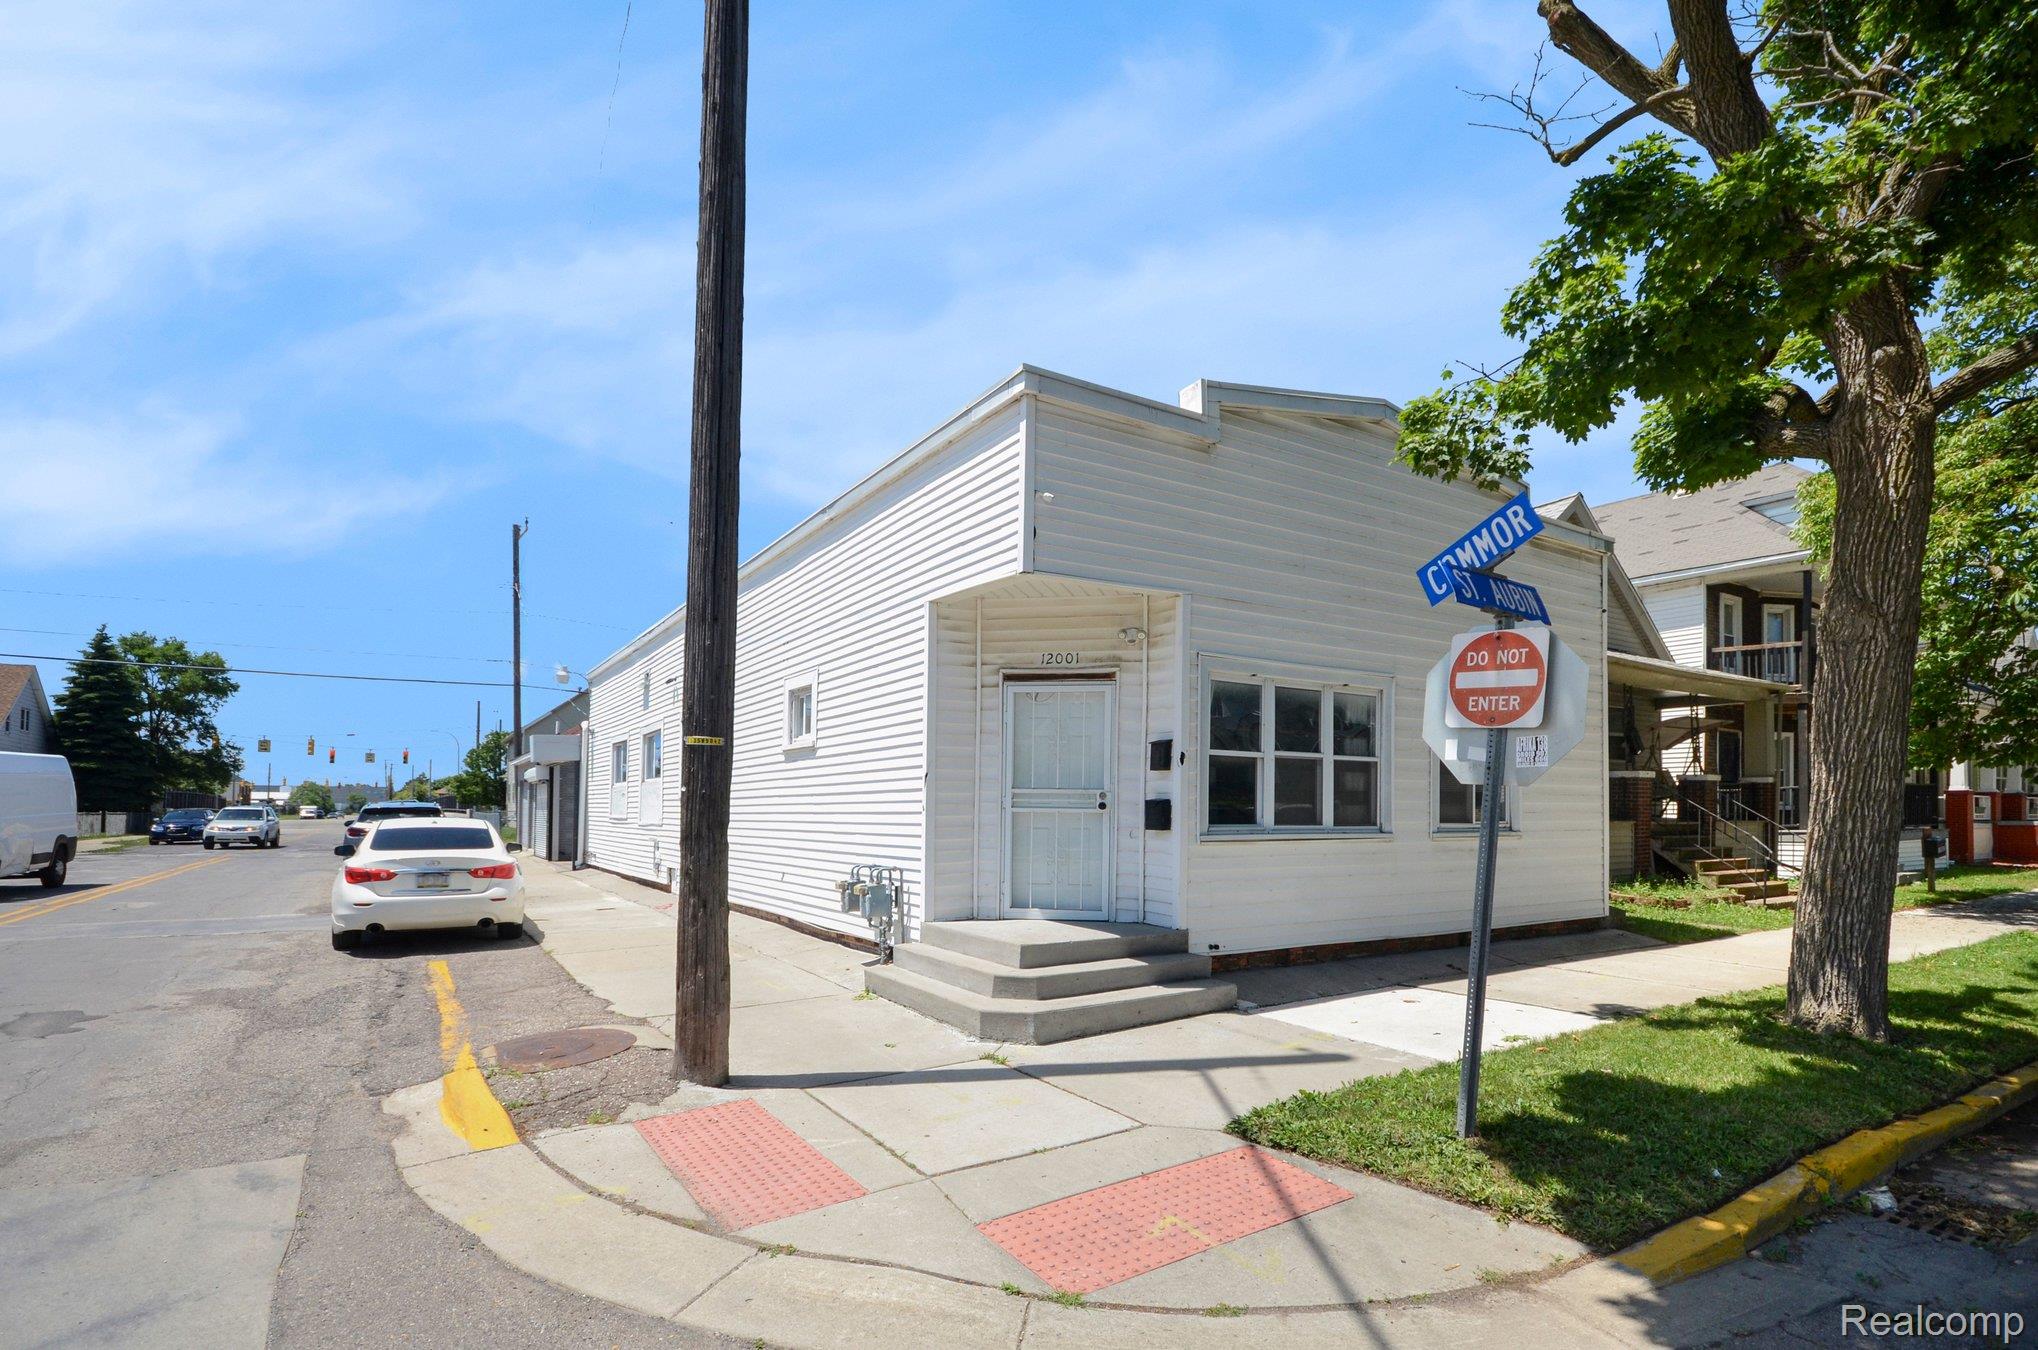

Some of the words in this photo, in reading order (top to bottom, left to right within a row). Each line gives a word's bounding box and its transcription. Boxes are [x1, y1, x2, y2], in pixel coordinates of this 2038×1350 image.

[1490, 579, 1542, 617] AUBIN
[1041, 653, 1079, 664] 12001
[1467, 651, 1489, 666] DO
[1496, 648, 1529, 664] NOT
[1468, 695, 1520, 711] ENTER
